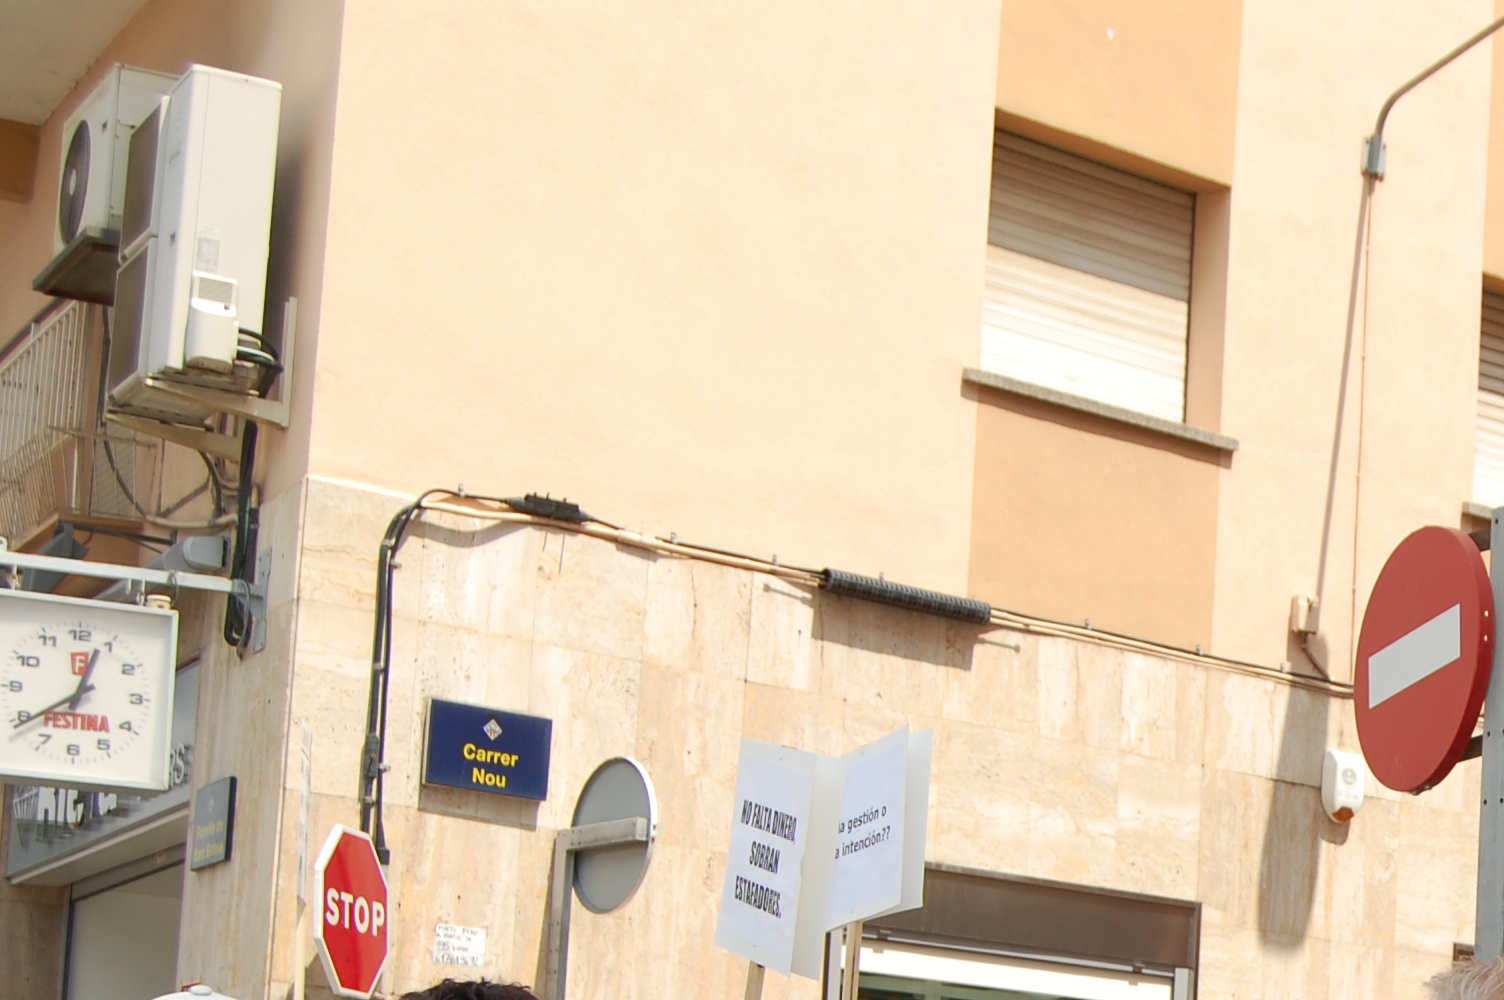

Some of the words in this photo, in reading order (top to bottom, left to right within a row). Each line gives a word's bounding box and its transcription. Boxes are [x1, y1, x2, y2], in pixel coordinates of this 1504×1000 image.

[38, 634, 57, 647] 11
[69, 630, 91, 641] 12
[104, 641, 113, 652] 1
[17, 655, 40, 667] 10
[122, 664, 135, 675] 2
[9, 680, 23, 692] 9
[130, 694, 143, 705] 3
[17, 711, 31, 722] 8
[43, 712, 110, 733] FESTINA
[119, 721, 133, 732] 4
[38, 734, 52, 745] 7
[97, 739, 111, 751] 5
[67, 744, 80, 756] 6
[463, 743, 519, 767] Carrer
[472, 767, 506, 788] Nou
[741, 799, 752, 824] NO
[750, 803, 772, 834] FALTA
[847, 806, 879, 834] gestión
[881, 805, 887, 817] o
[749, 841, 780, 874] SOBRAN
[325, 887, 385, 937] STOP
